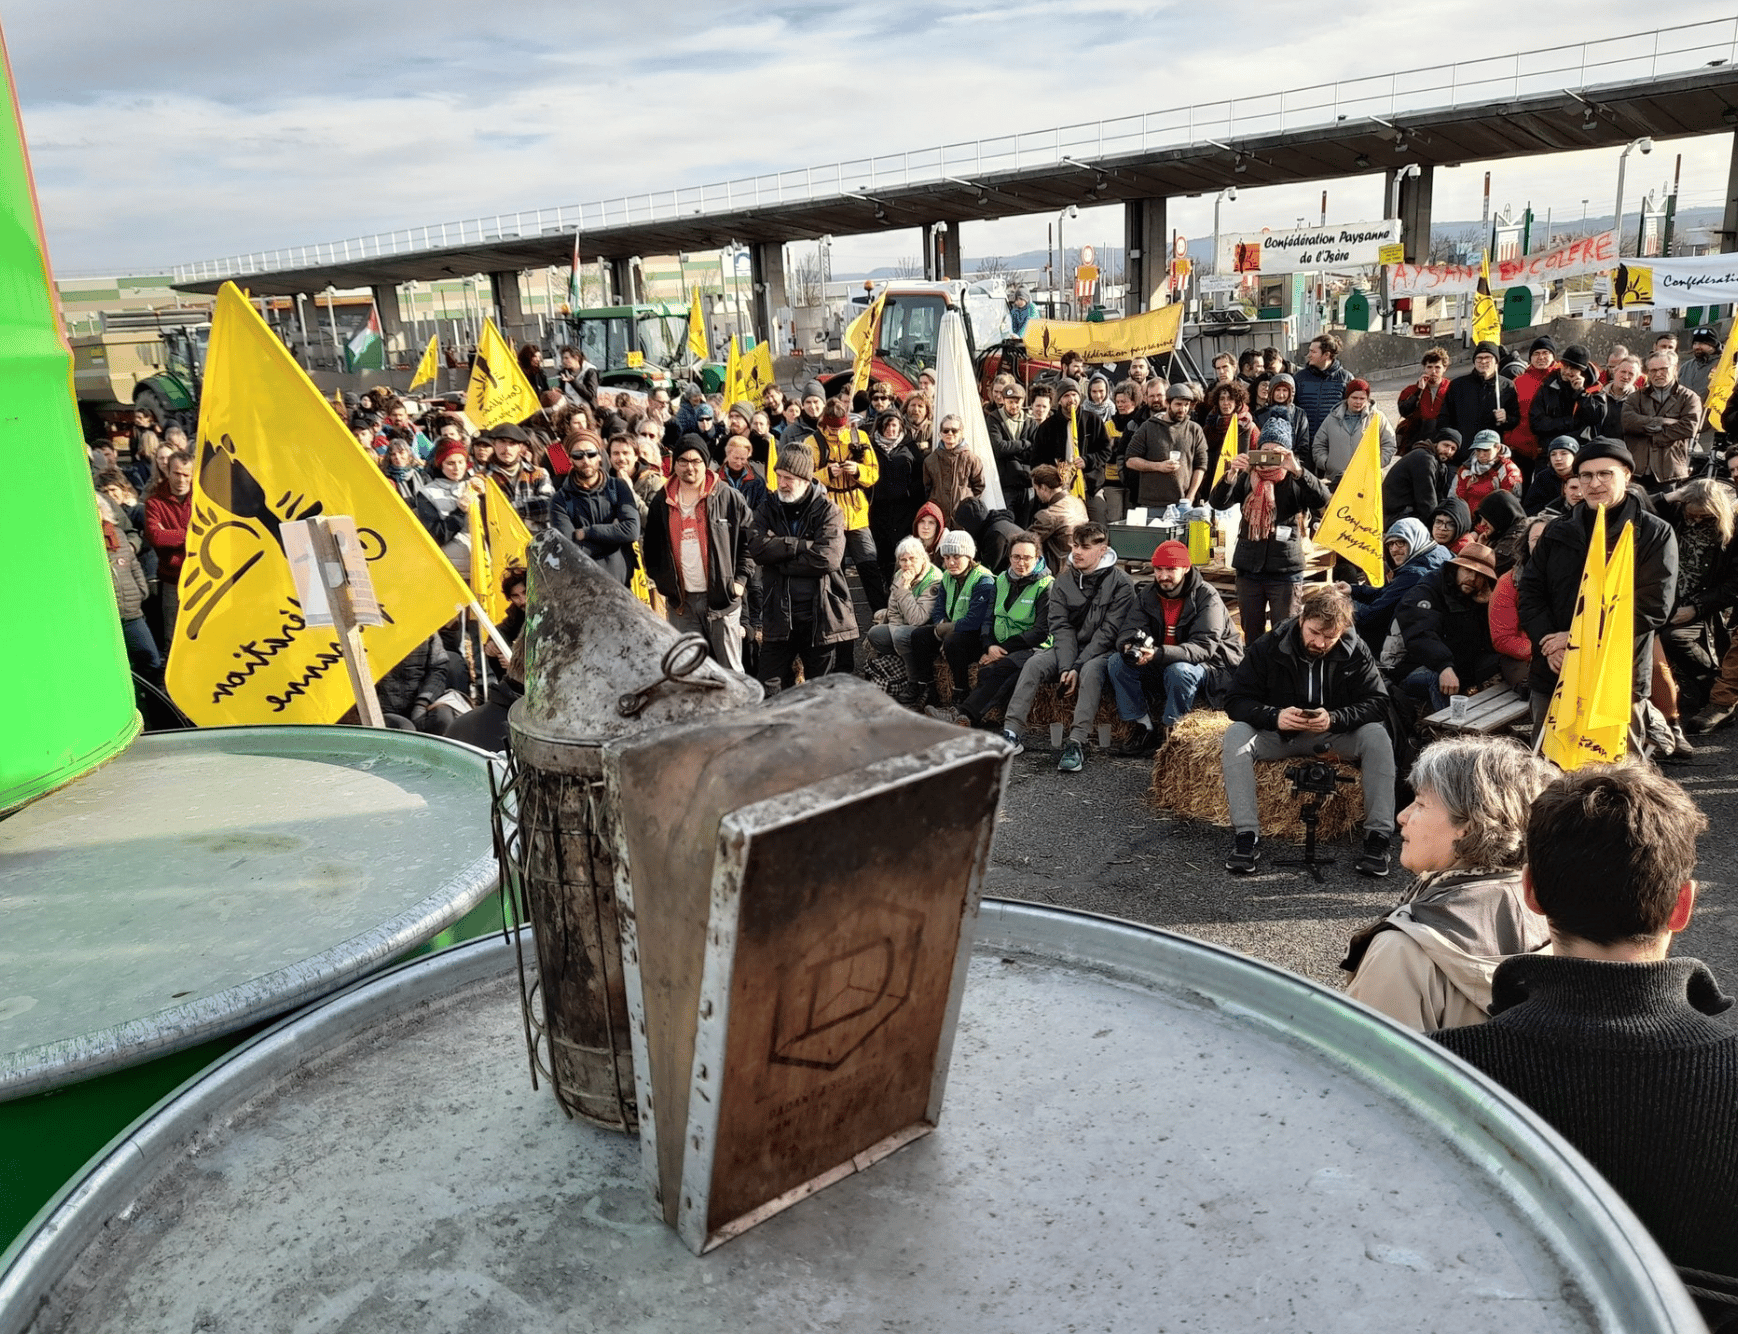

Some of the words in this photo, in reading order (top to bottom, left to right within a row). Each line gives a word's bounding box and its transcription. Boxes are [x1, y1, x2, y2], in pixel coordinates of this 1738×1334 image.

[1264, 231, 1335, 250] Confédération
[1339, 229, 1390, 245] Paysanne
[1299, 251, 1312, 264] de
[1386, 262, 1484, 291] AYSAN
[1663, 273, 1738, 290] Confédérati
[1082, 348, 1128, 360] fédération
